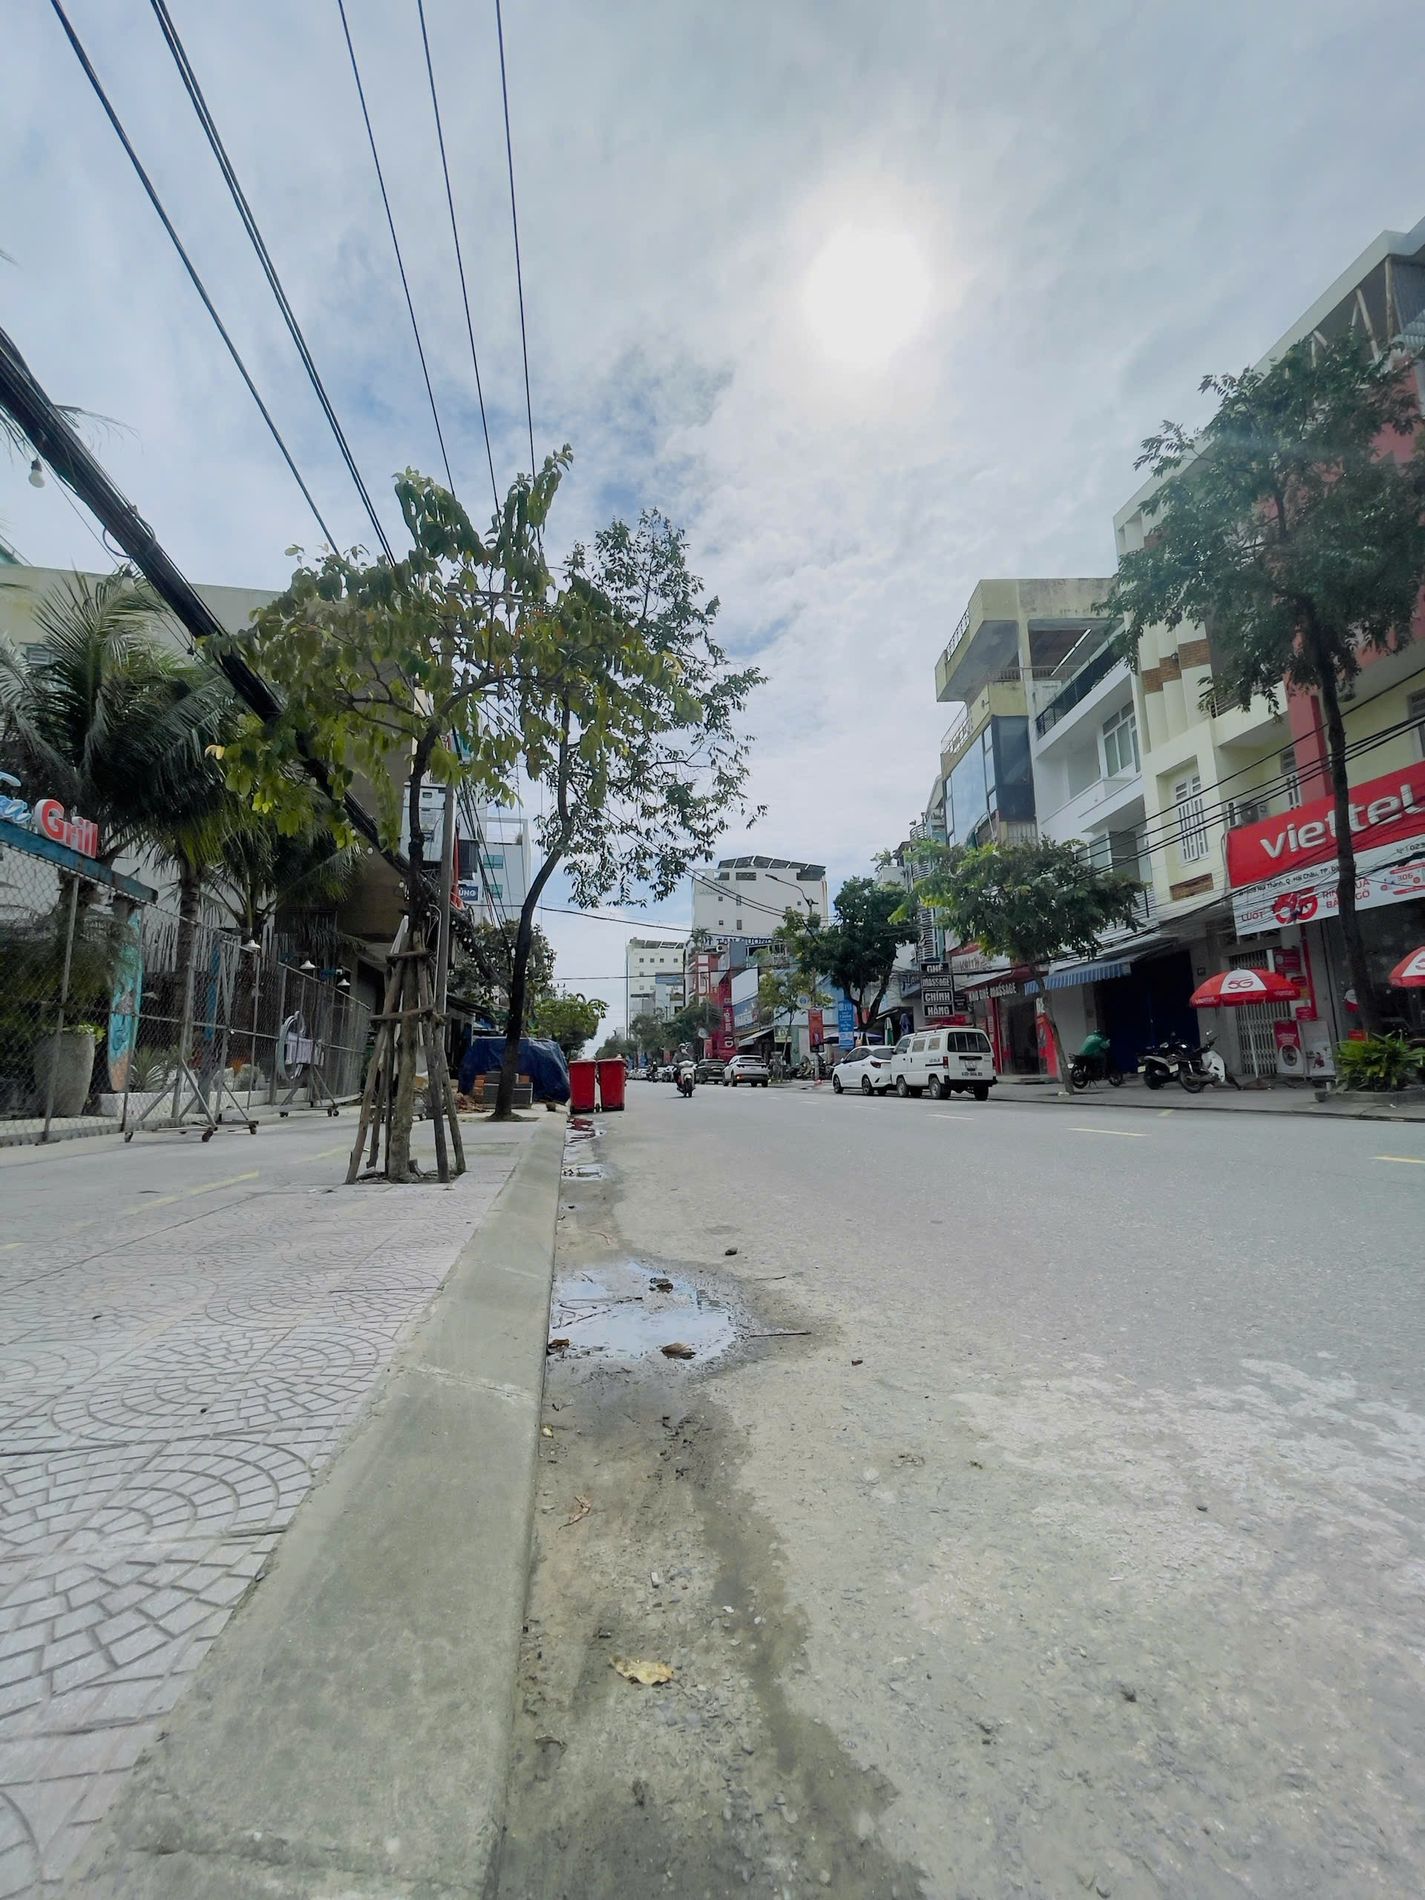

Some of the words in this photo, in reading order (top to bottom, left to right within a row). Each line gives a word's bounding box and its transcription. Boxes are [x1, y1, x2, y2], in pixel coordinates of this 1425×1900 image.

[37, 799, 98, 859] Grill
[1260, 784, 1425, 858] viettel
[923, 977, 950, 987] MASSAGE
[1227, 978, 1254, 990] 5G
